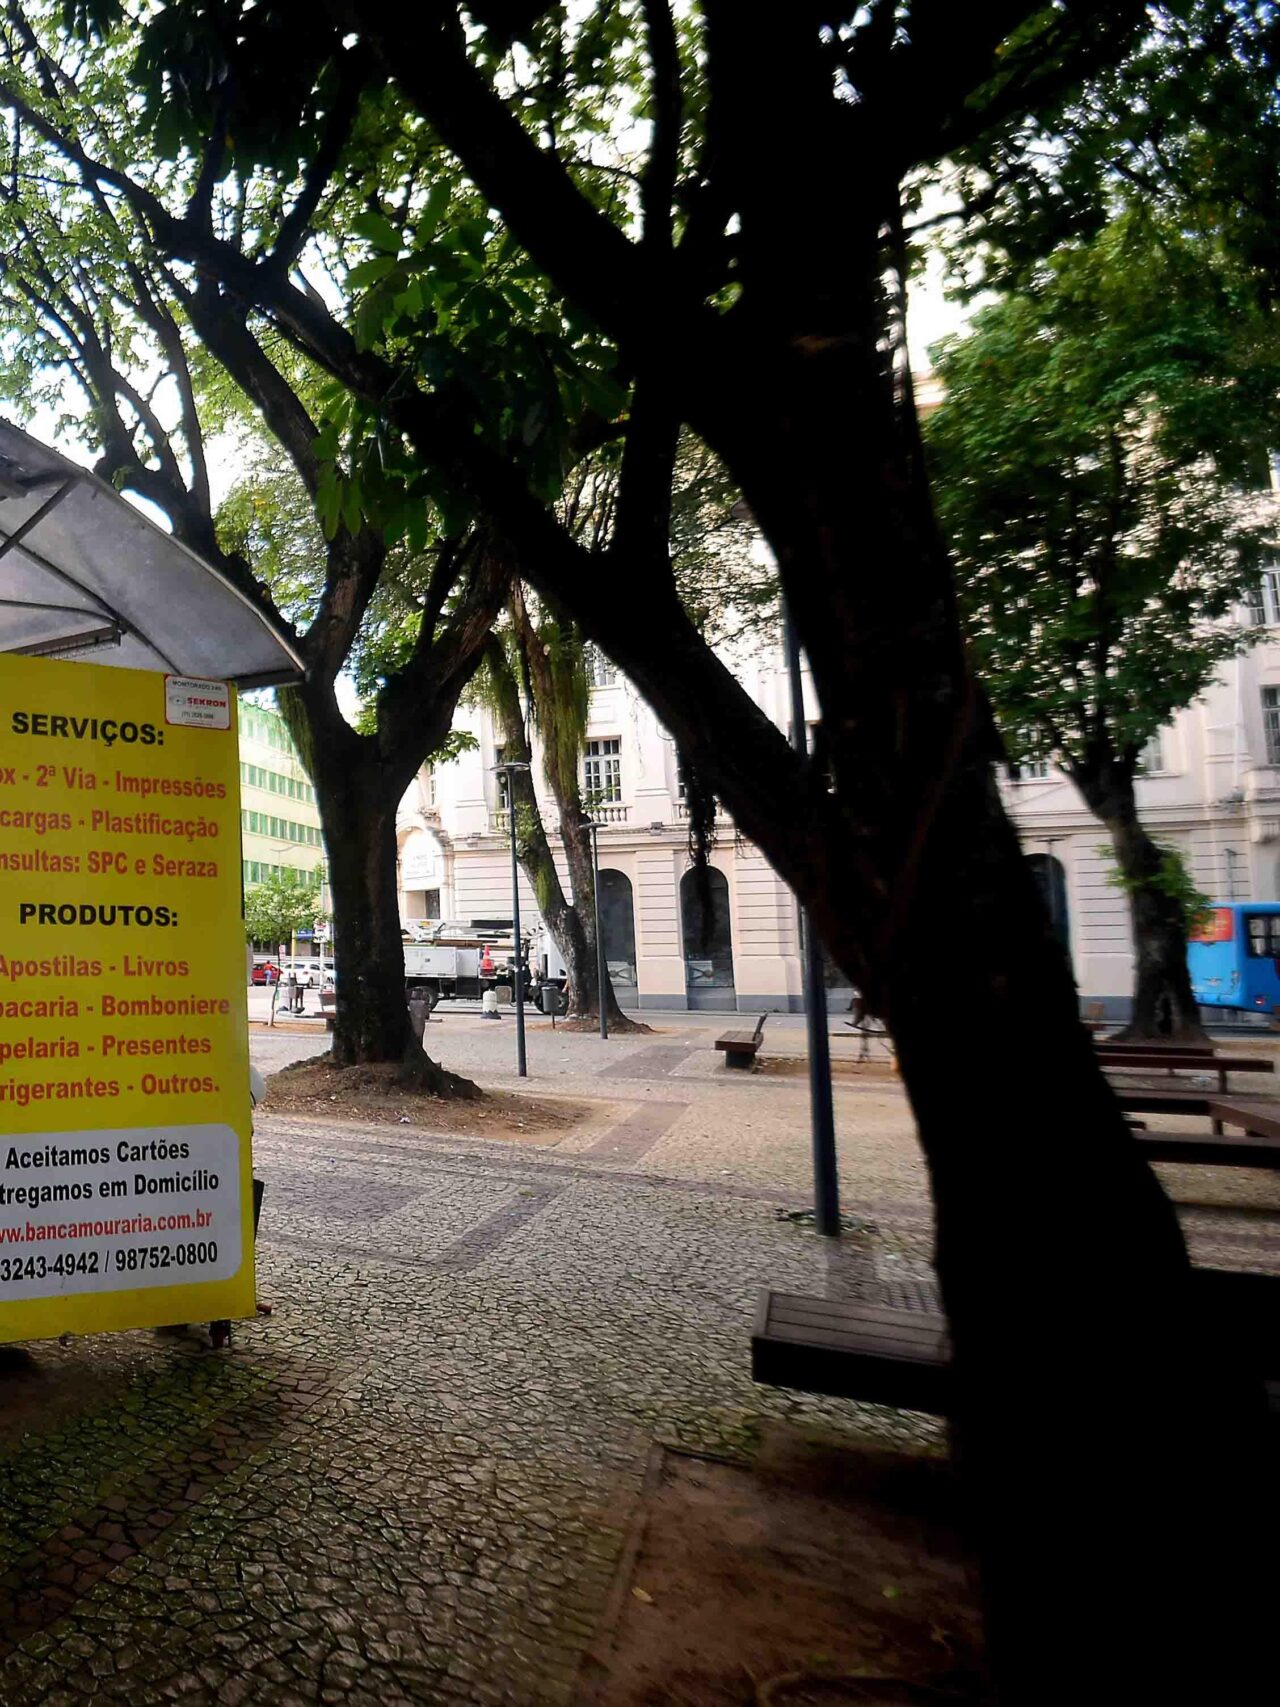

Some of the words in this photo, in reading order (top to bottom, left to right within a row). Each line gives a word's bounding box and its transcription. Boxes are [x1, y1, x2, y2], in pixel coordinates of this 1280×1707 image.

[187, 696, 227, 708] SEKRON
[11, 711, 165, 747] SERVIÇOS:
[64, 767, 97, 791] Via
[115, 770, 227, 800] Impressões
[91, 809, 219, 843] Plastificação
[88, 850, 128, 875] SPC
[134, 859, 146, 875] e
[152, 854, 219, 878] Seraza
[19, 903, 179, 927] PRODUTOS:
[123, 954, 189, 977] Livros
[101, 994, 230, 1017] Bomboniere
[101, 1034, 212, 1057] Presentes
[141, 1073, 220, 1096] Outros.
[5, 1144, 110, 1170] Aceitamos
[116, 1138, 190, 1163] Cartões
[99, 1181, 128, 1198] em
[134, 1170, 220, 1196] Domicílio
[0, 1251, 99, 1282] 3243-4942
[104, 1250, 110, 1273] /
[115, 1240, 218, 1272] 98752-0800
